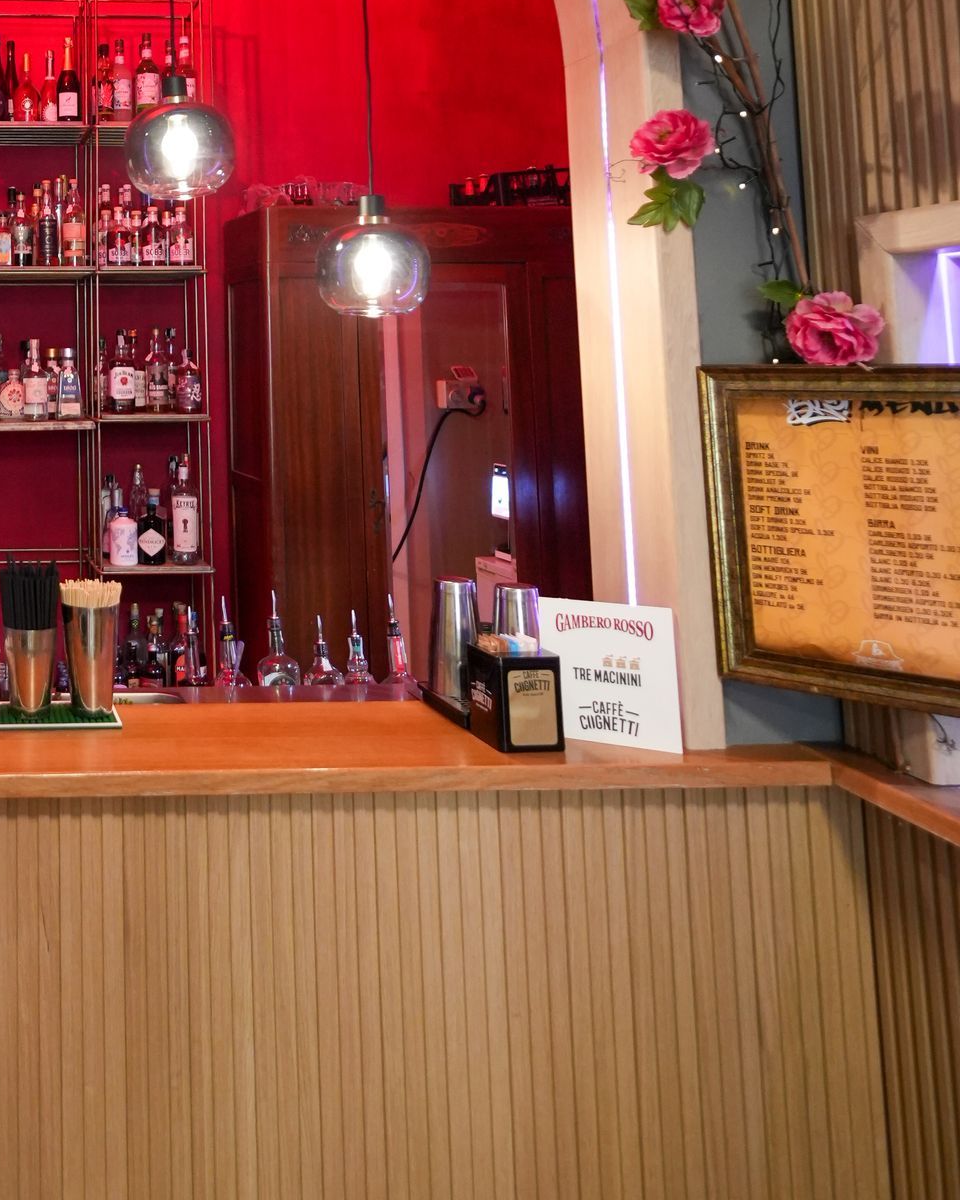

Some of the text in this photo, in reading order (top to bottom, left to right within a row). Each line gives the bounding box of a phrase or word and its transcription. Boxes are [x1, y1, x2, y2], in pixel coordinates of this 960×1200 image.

[745, 442, 769, 450] DRINK
[750, 505, 800, 516] SOFT DRINK
[555, 612, 654, 641] GAMBERO ROSSO
[573, 666, 642, 687] TRE MACININI
[592, 700, 624, 717] CAFFÈ
